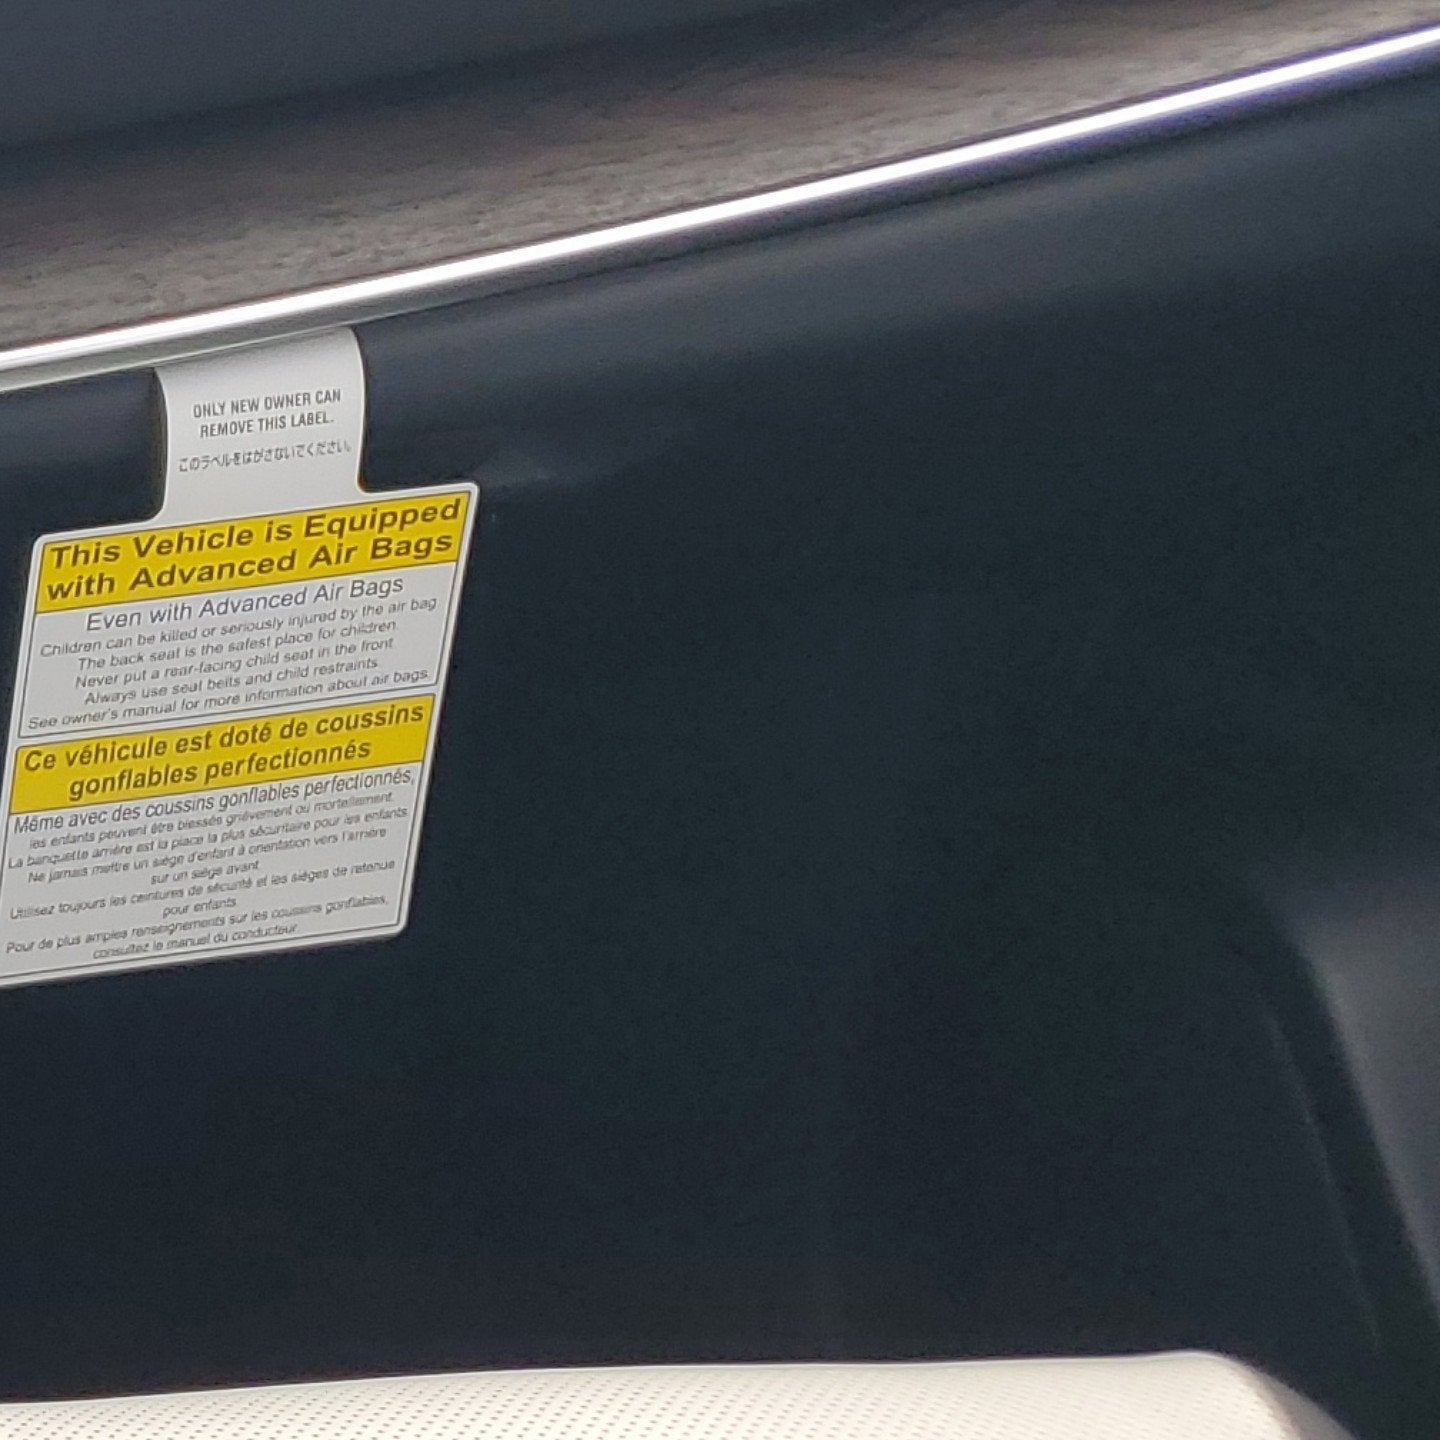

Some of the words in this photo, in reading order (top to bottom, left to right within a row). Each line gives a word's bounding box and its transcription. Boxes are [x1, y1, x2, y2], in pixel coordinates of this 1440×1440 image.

[193, 401, 227, 419] ONLY
[231, 397, 260, 414] NEW
[264, 391, 312, 411] OWNER
[316, 388, 342, 405] CAN
[200, 419, 255, 439] REMOVE
[258, 415, 287, 432] THIS
[291, 411, 336, 428] LABEL.
[50, 541, 120, 568] This
[133, 525, 253, 557] Vehicle
[265, 519, 292, 543] is
[304, 498, 460, 538] Equipped
[47, 572, 114, 600] with
[129, 549, 296, 590] Advanced
[308, 542, 358, 568] Air
[370, 534, 452, 560] Bags
[86, 611, 141, 631] Even
[149, 601, 192, 623] with
[198, 586, 307, 617] Advanced
[312, 582, 344, 603] Air
[349, 578, 403, 599] Bags
[24, 749, 56, 772] Ce
[65, 735, 167, 766] véhicule
[174, 729, 212, 753] est
[218, 720, 271, 747] doté
[279, 716, 308, 739] de
[315, 704, 423, 734] coussins
[69, 764, 197, 801] gonflables
[204, 739, 370, 784] perfectionnés
[67, 810, 108, 827] avec
[110, 803, 141, 822] des
[144, 796, 214, 817] coussins
[218, 783, 299, 812] gonflables
